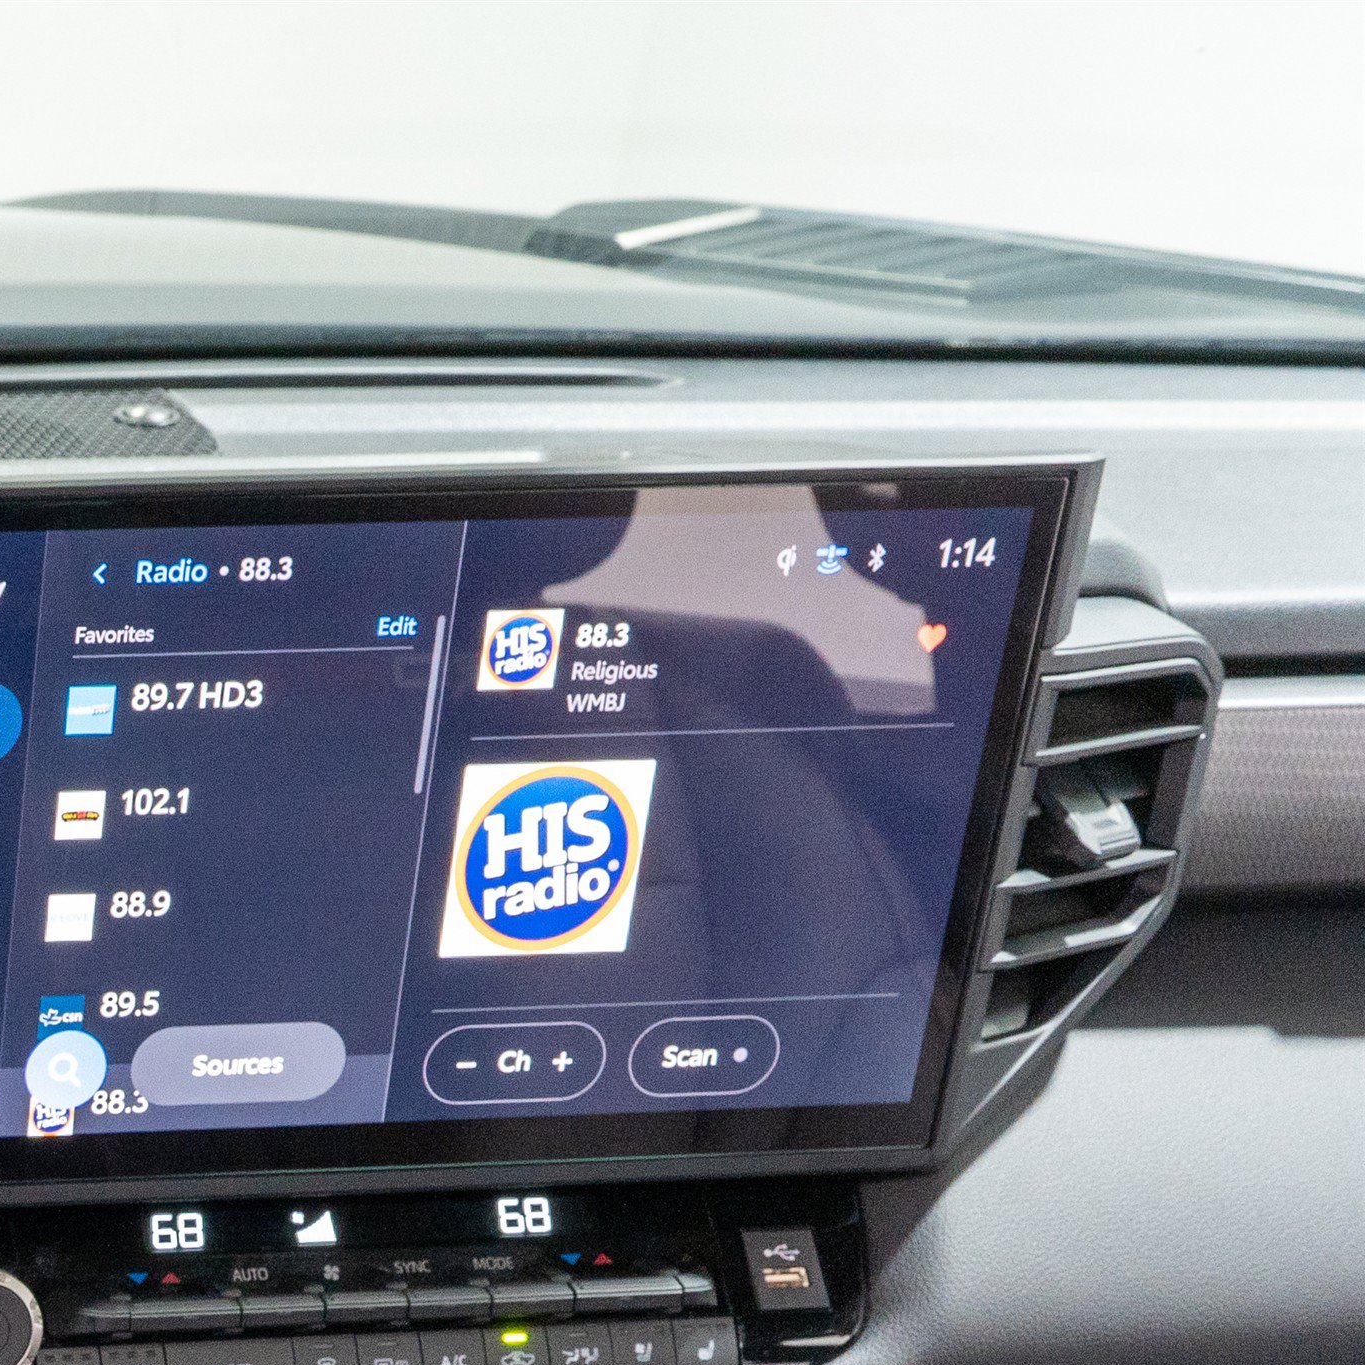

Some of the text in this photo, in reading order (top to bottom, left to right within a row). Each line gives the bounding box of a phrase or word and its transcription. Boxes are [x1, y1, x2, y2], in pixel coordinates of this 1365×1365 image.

[938, 538, 996, 569] 1:14
[135, 557, 294, 584] Radio 88.3
[74, 625, 155, 645] Favorites
[376, 616, 418, 638] Edit
[575, 622, 629, 648] 88.3
[495, 623, 547, 658] HIS
[495, 651, 547, 674] radio
[571, 660, 658, 685] Religious
[131, 682, 193, 711] 89.7
[200, 680, 264, 709] HD3
[567, 692, 627, 713] WMBJ
[121, 788, 190, 816] 102.1
[483, 794, 610, 878] HIS
[110, 890, 171, 918] 88.9
[482, 864, 611, 920] radio
[100, 990, 160, 1018] 89.5
[191, 1053, 285, 1078] Sources
[497, 1048, 531, 1073] Ch
[661, 1045, 718, 1068] Scan
[497, 1197, 552, 1235] 68
[151, 1212, 205, 1250] 68
[232, 1267, 269, 1283] AUTO
[393, 1259, 432, 1275] SYNC
[472, 1255, 514, 1271] MODE
